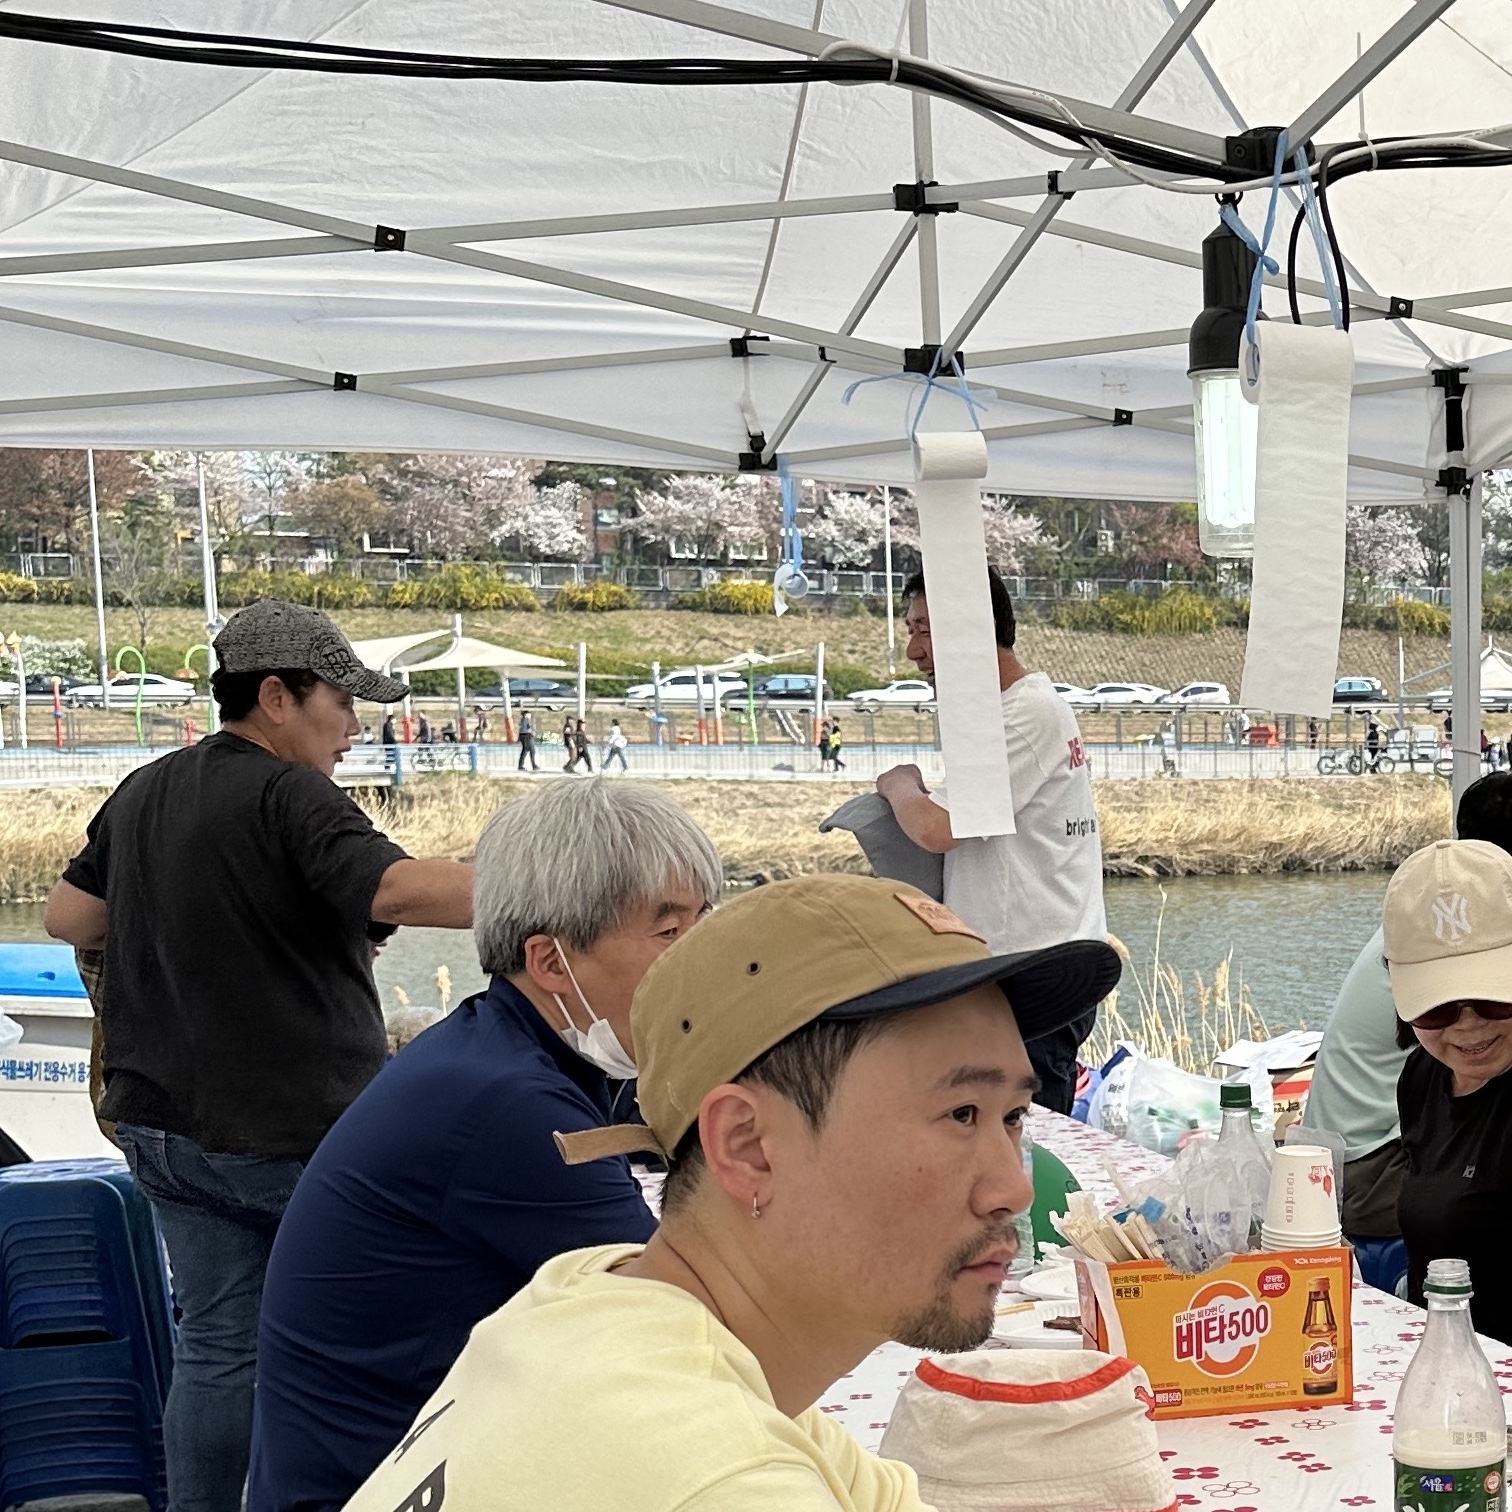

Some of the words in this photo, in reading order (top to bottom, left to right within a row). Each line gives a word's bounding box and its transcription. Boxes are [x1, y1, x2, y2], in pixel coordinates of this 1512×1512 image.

[1431, 893, 1472, 942] NY
[1175, 1313, 1196, 1324] 마시는
[1175, 1304, 1269, 1361] 비타500
